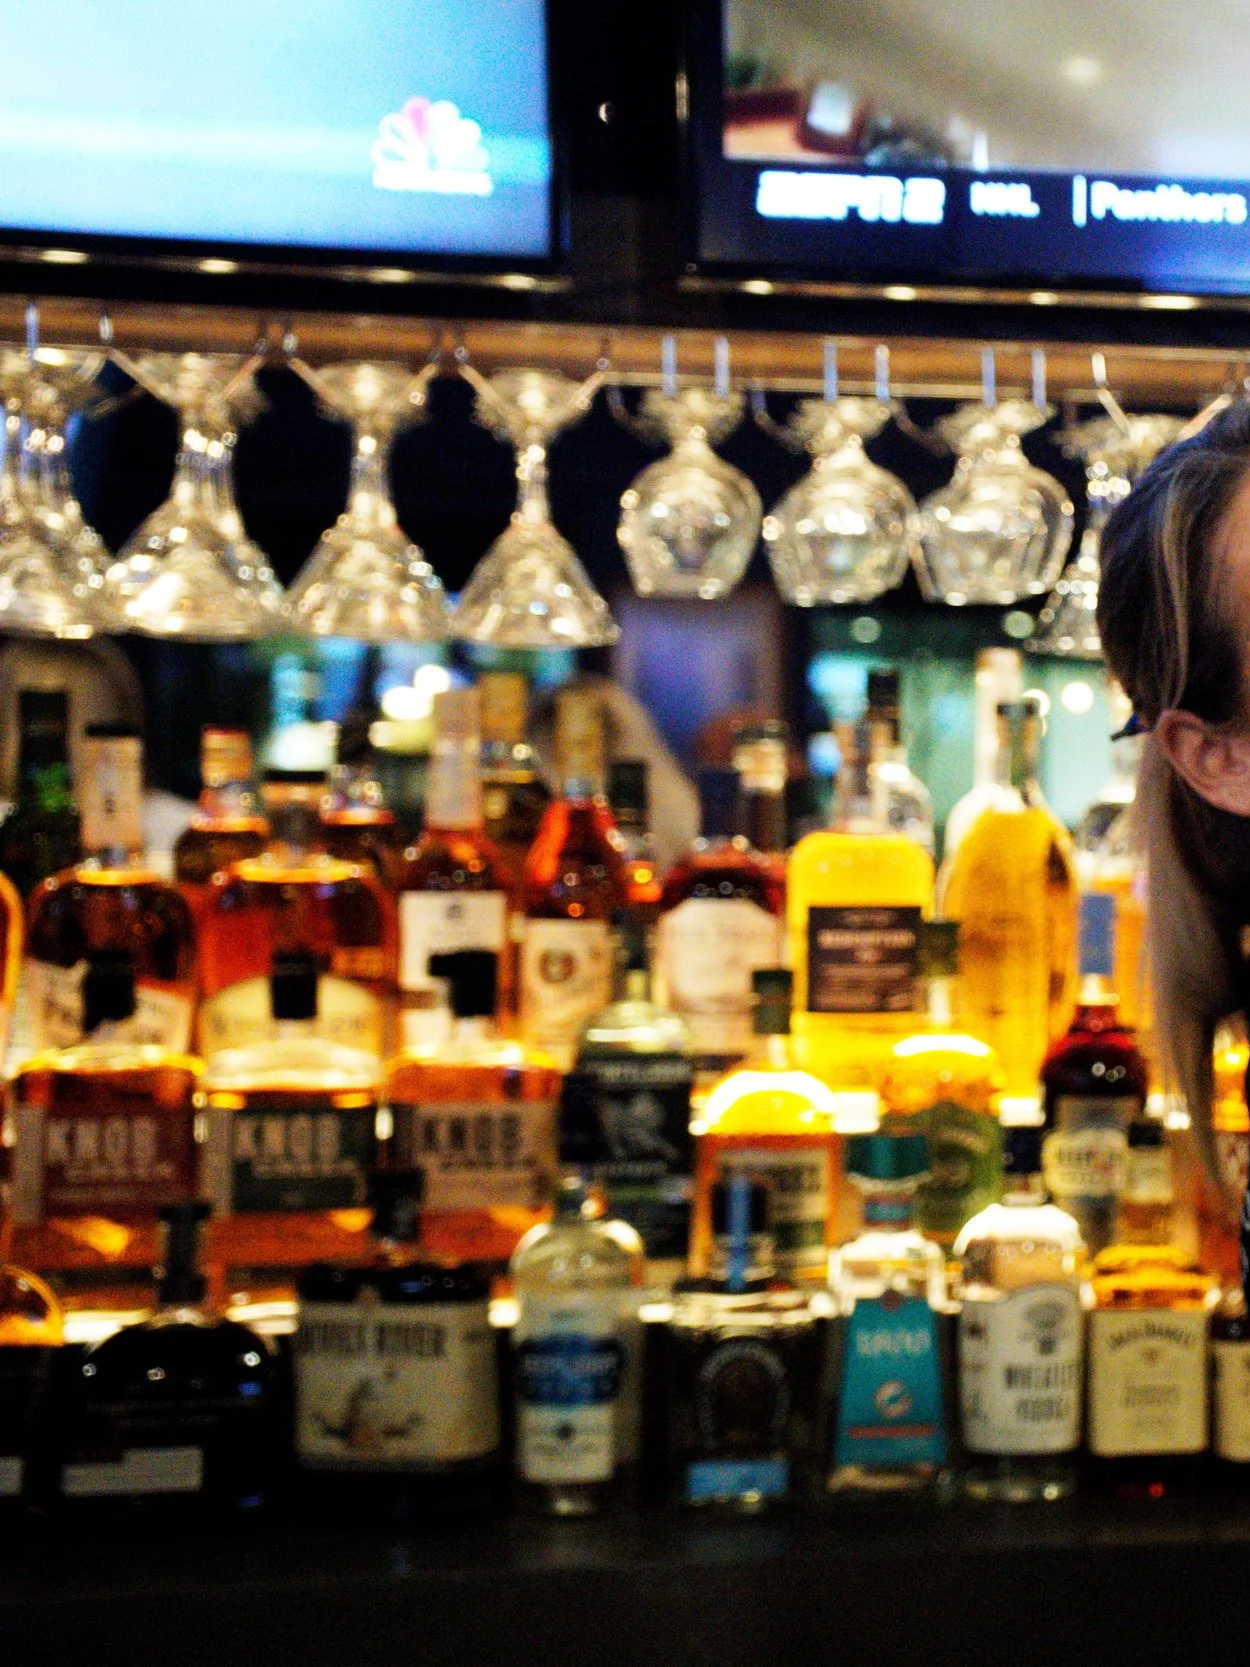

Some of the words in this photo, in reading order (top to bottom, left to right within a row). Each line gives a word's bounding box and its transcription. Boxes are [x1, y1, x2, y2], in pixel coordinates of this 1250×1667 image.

[1091, 181, 1247, 225] Panthers
[46, 1115, 156, 1165] KNOB
[234, 1112, 342, 1160] KNOB
[420, 1112, 526, 1154] KNOB
